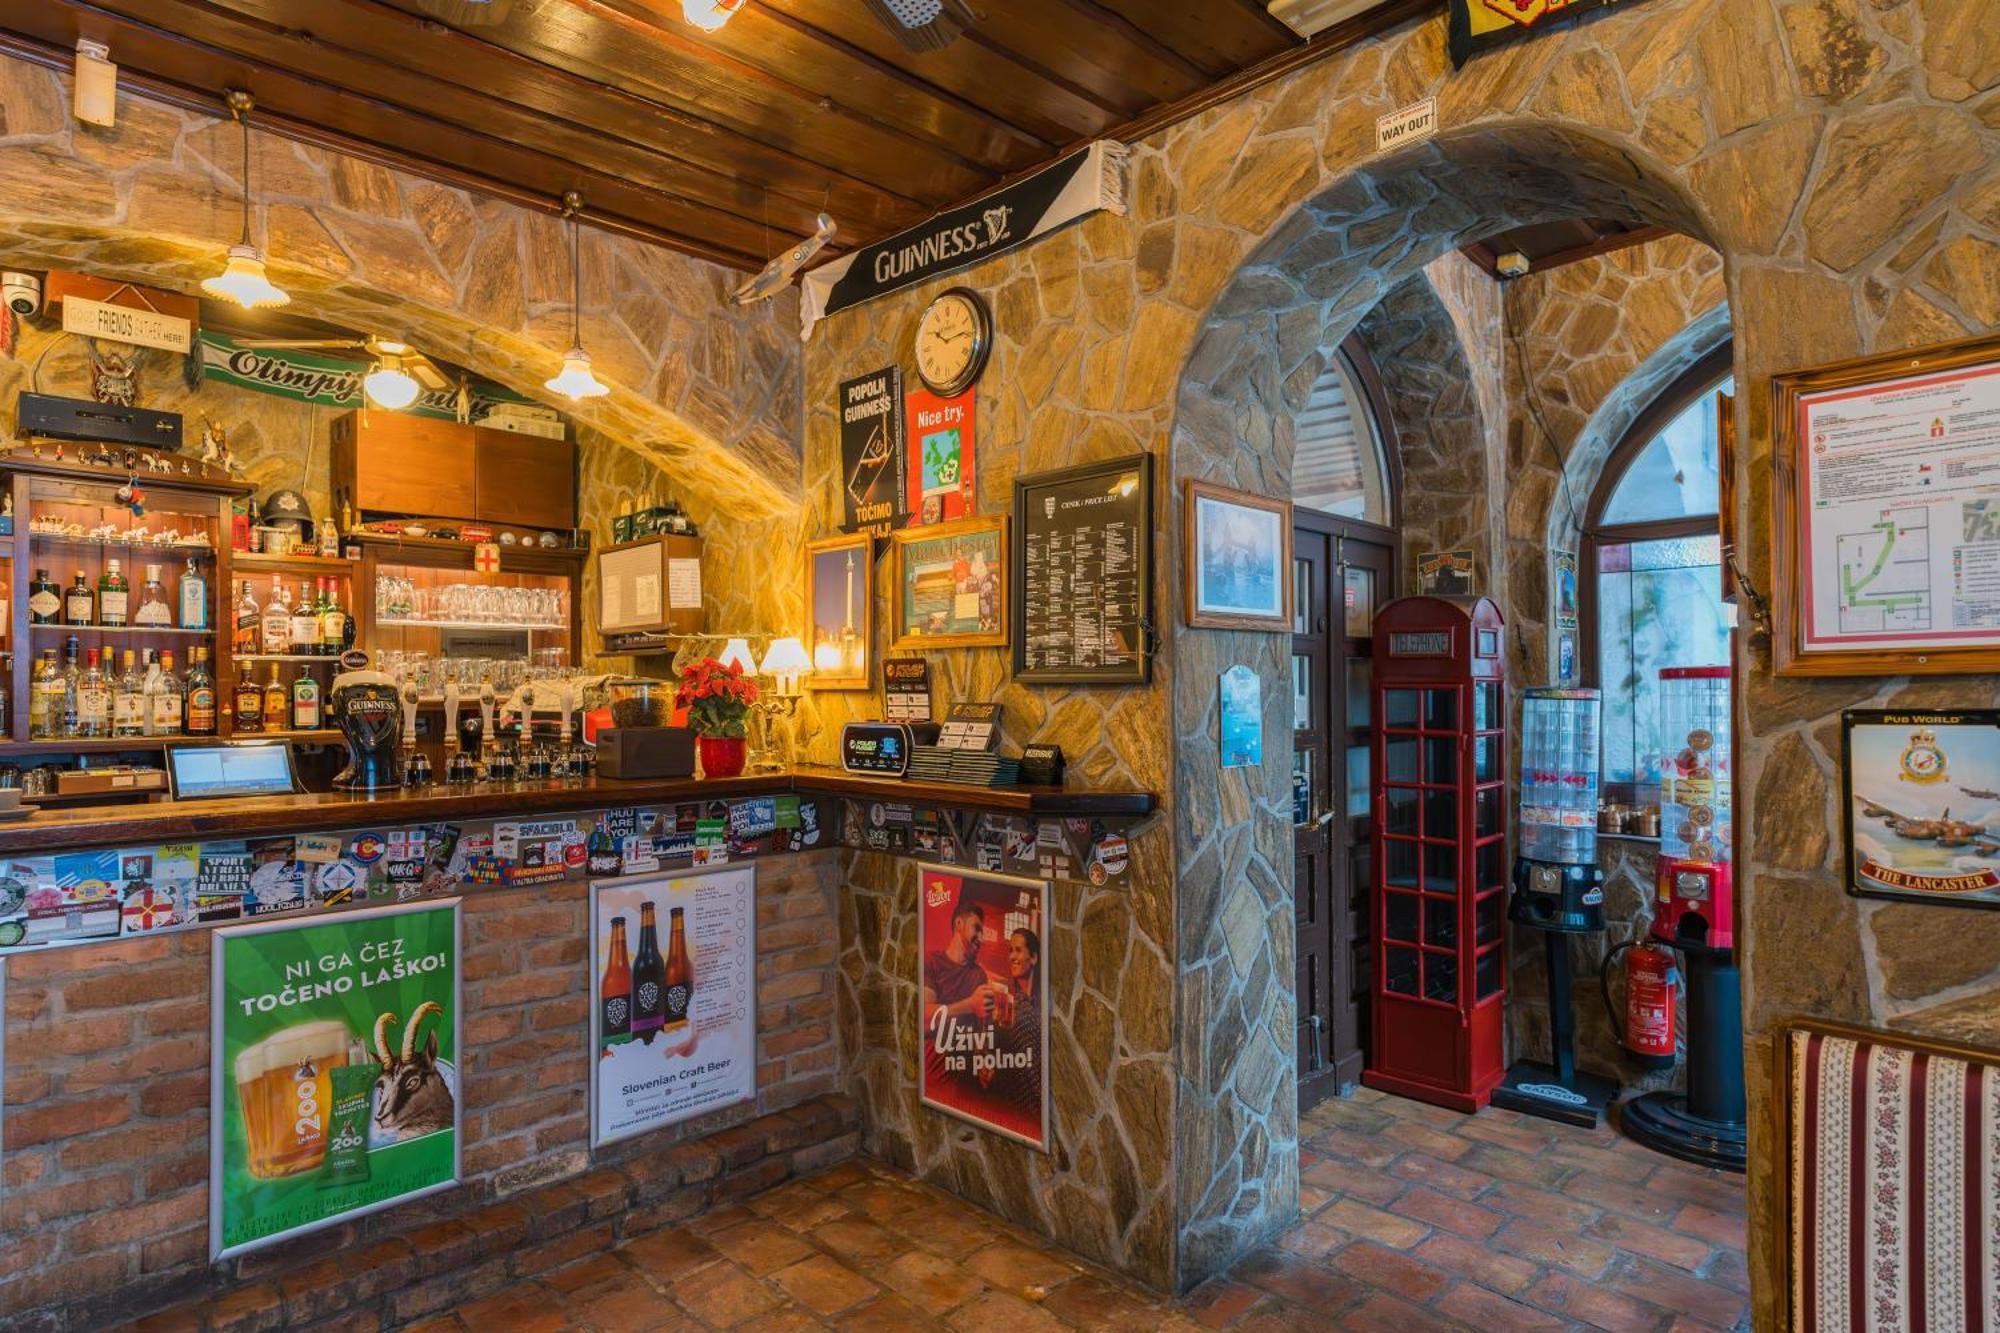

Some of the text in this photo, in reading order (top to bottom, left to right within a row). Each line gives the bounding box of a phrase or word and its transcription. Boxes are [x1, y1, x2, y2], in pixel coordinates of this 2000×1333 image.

[1382, 114, 1430, 142] WAY OUT
[875, 221, 977, 283] GUINNESS
[98, 308, 133, 337] FRIENDS
[229, 350, 361, 401] Olimpij
[848, 377, 886, 403] POPOLN
[845, 395, 892, 424] GUINNESS
[918, 404, 965, 429] Nice try.
[856, 501, 892, 523] TOČIMO
[347, 700, 397, 713] GUINNESS
[1884, 715, 1961, 724] PUB WORLD
[611, 819, 634, 827] ARE
[208, 857, 244, 866] SPORT
[1874, 866, 1987, 891] THE LANCASTER
[285, 938, 406, 981] NI GA ČEZ
[240, 952, 447, 1017] TOČENO LAŠKO!
[930, 1004, 995, 1054] Uživi
[944, 1047, 1033, 1077] na polno!
[622, 1059, 732, 1096] Slovenian Craft Beer
[296, 1080, 321, 1135] 200
[331, 1136, 364, 1153] 200
